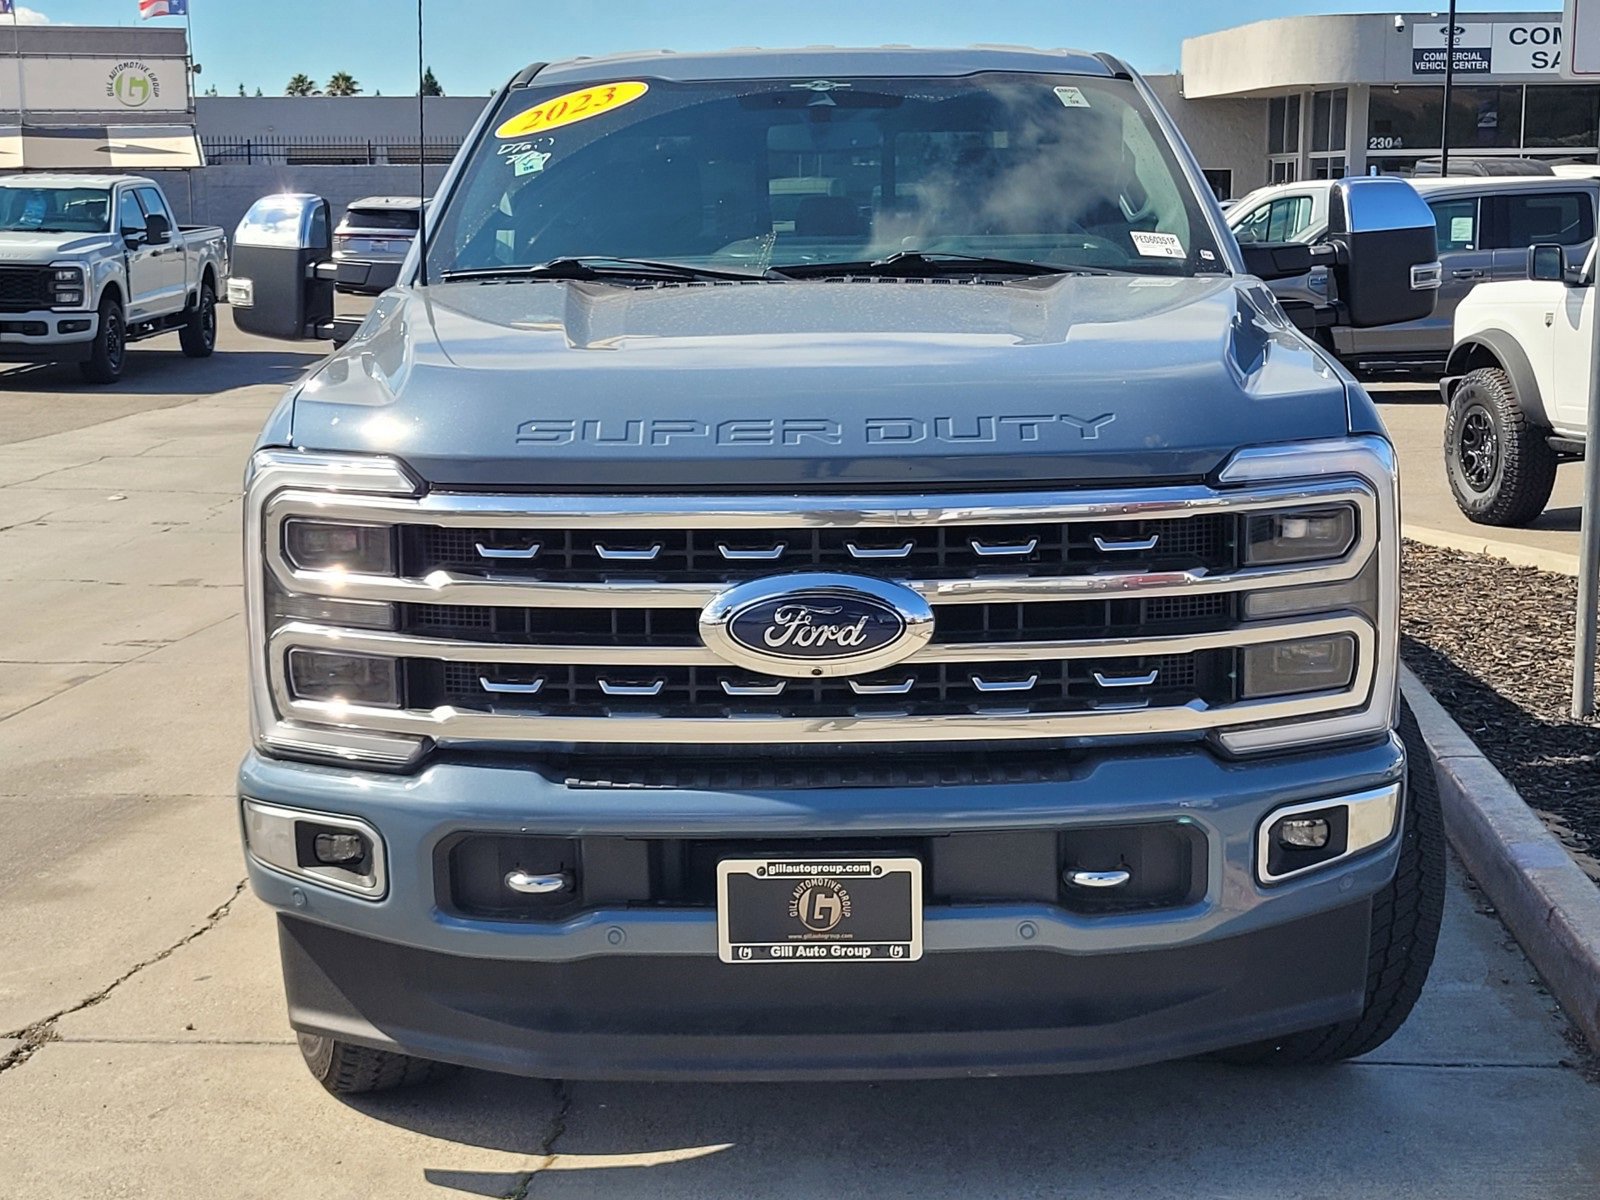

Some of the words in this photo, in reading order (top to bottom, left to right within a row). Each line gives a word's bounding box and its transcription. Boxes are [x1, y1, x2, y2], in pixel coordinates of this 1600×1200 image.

[109, 61, 150, 80] AUTOMOTIVE
[1415, 61, 1448, 70] VEHICL
[1453, 61, 1488, 70] CENTER
[106, 82, 114, 97] GILL
[147, 72, 160, 98] GROUP
[520, 86, 617, 131] 2023
[1369, 136, 1403, 149] 2304
[515, 418, 842, 446] SUPER
[865, 412, 1116, 444] DUTY
[764, 604, 869, 647] Ford
[768, 863, 871, 875] gillautogroup.com
[792, 878, 842, 899] AUTOMOTIVE
[788, 900, 799, 918] GILL
[838, 889, 851, 918] GROUP
[770, 946, 793, 957] Gill
[796, 945, 827, 957] Auto
[830, 945, 872, 958] Group
